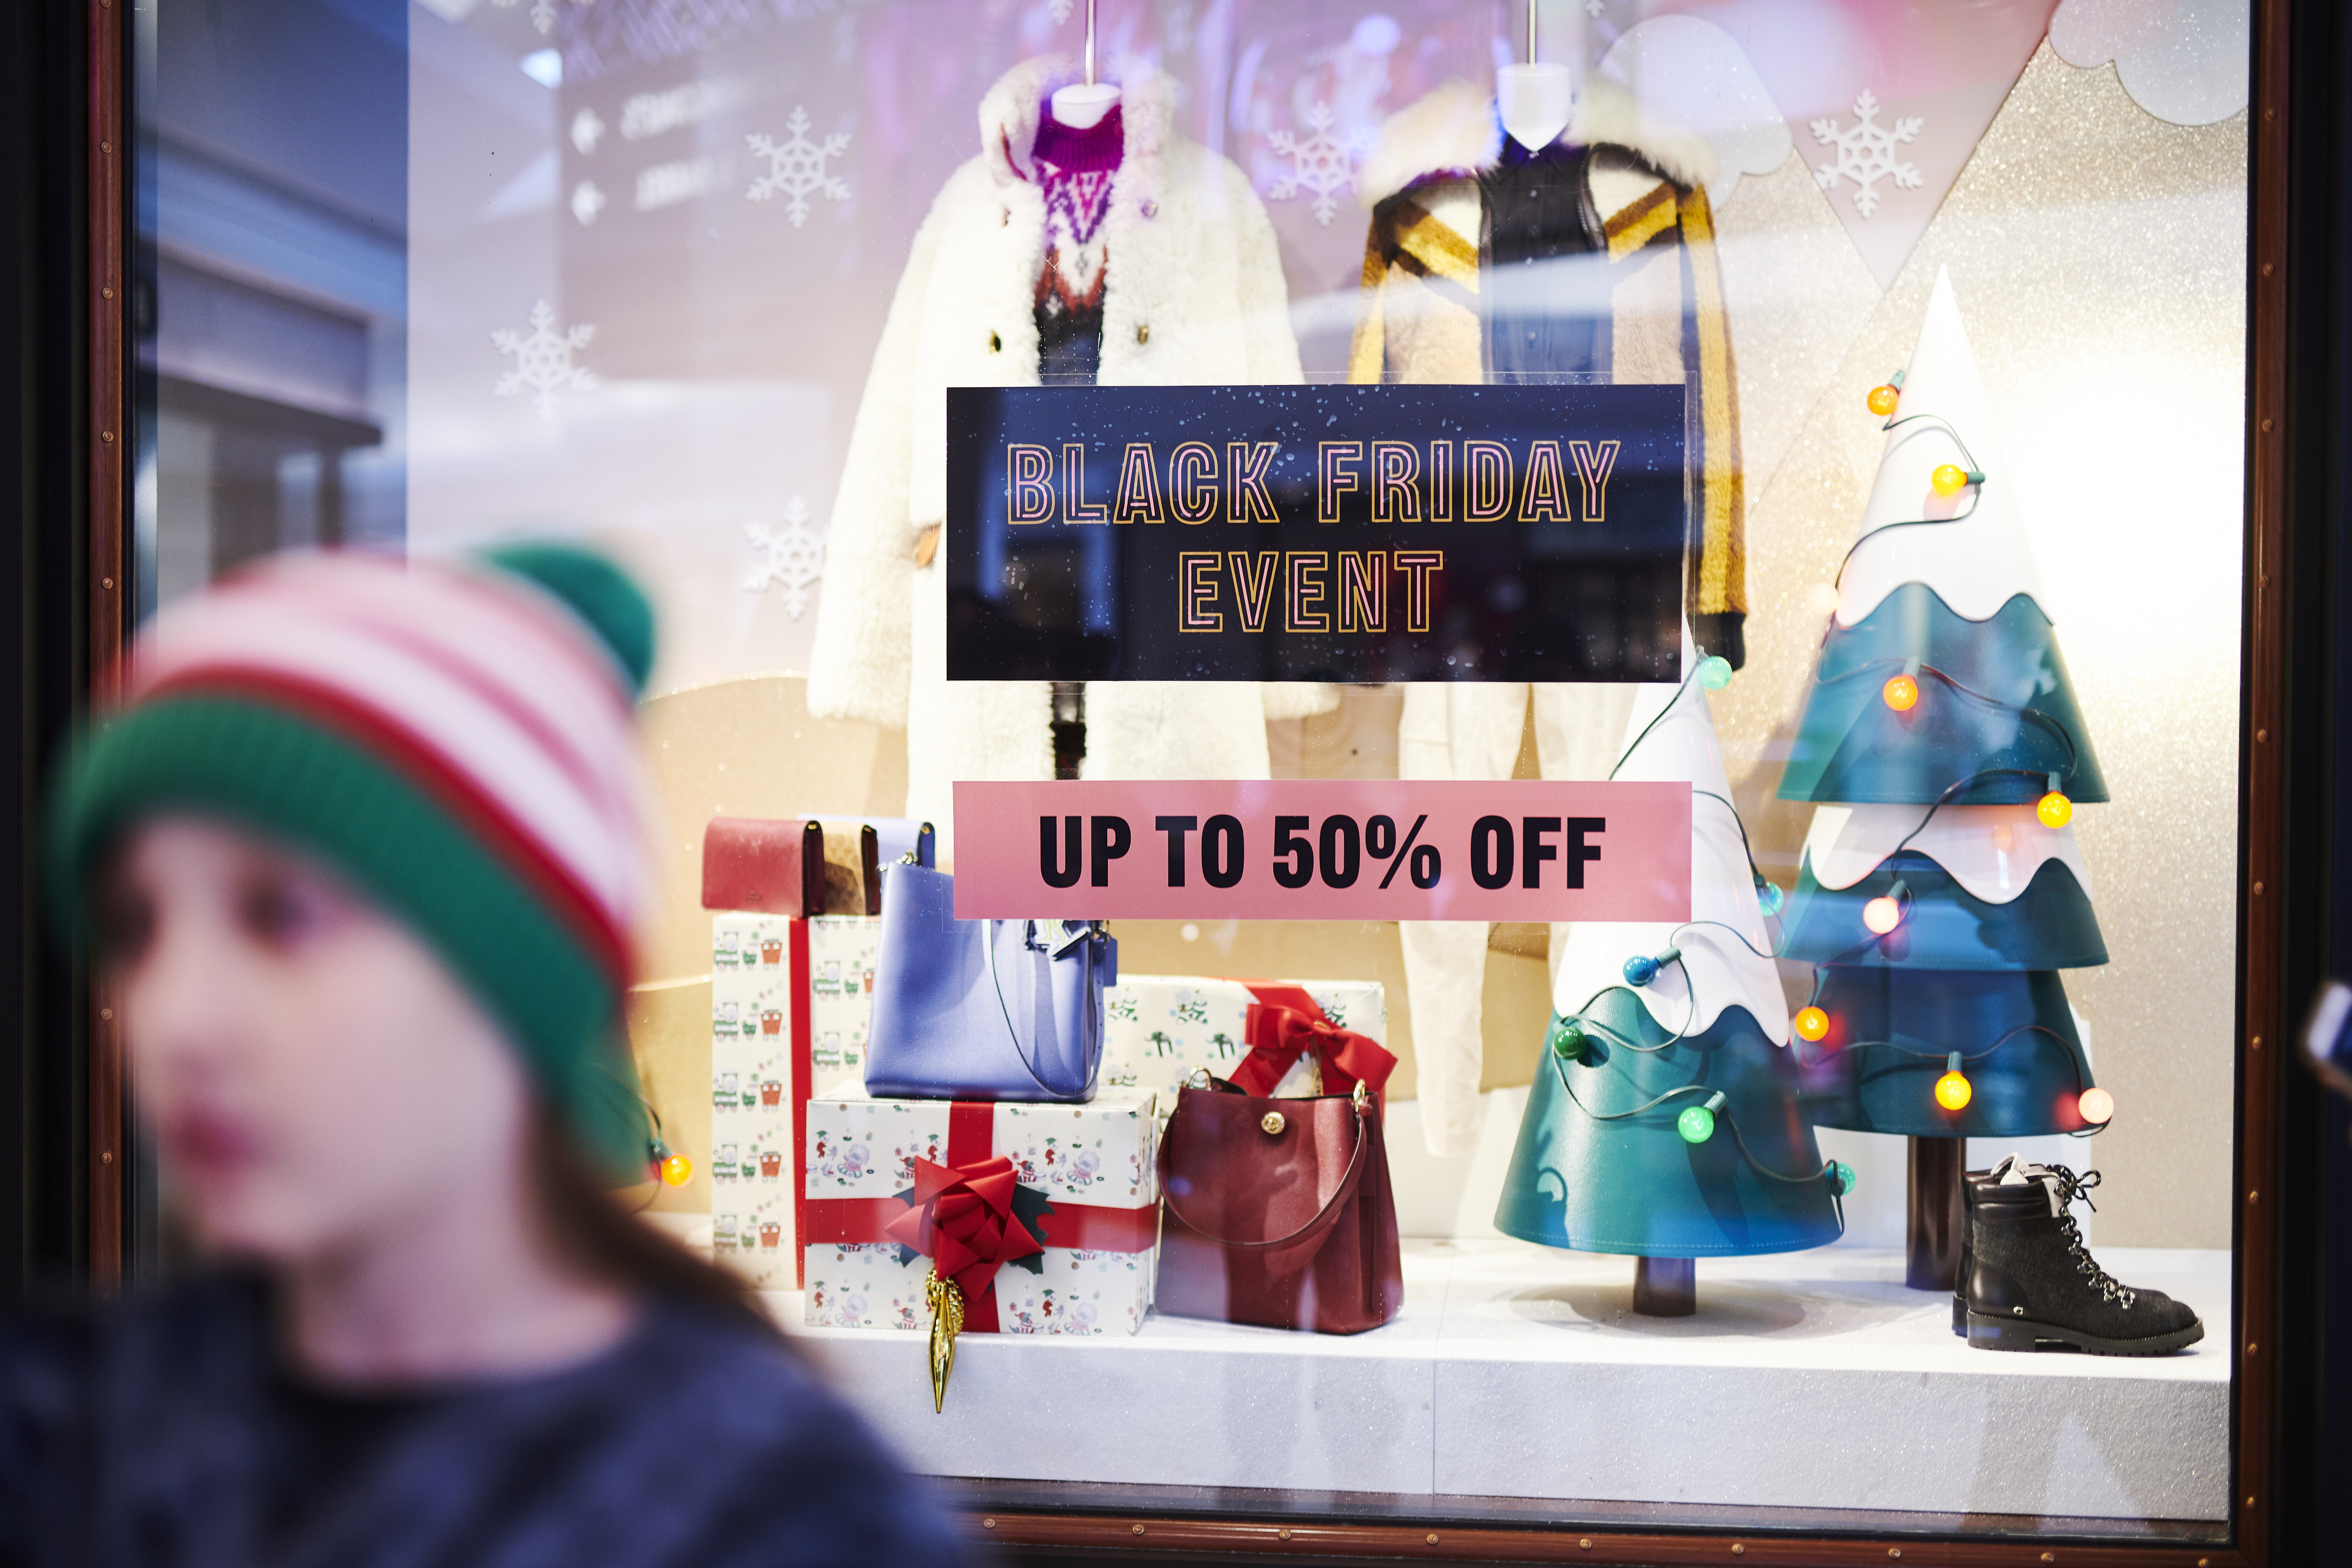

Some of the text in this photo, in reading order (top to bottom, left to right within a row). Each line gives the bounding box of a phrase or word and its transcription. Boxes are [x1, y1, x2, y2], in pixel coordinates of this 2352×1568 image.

[1008, 440, 1621, 524] BLACK FRIDAY
[1180, 551, 1444, 633] EVENT
[1040, 814, 1606, 890] UP TO 50% OFF
